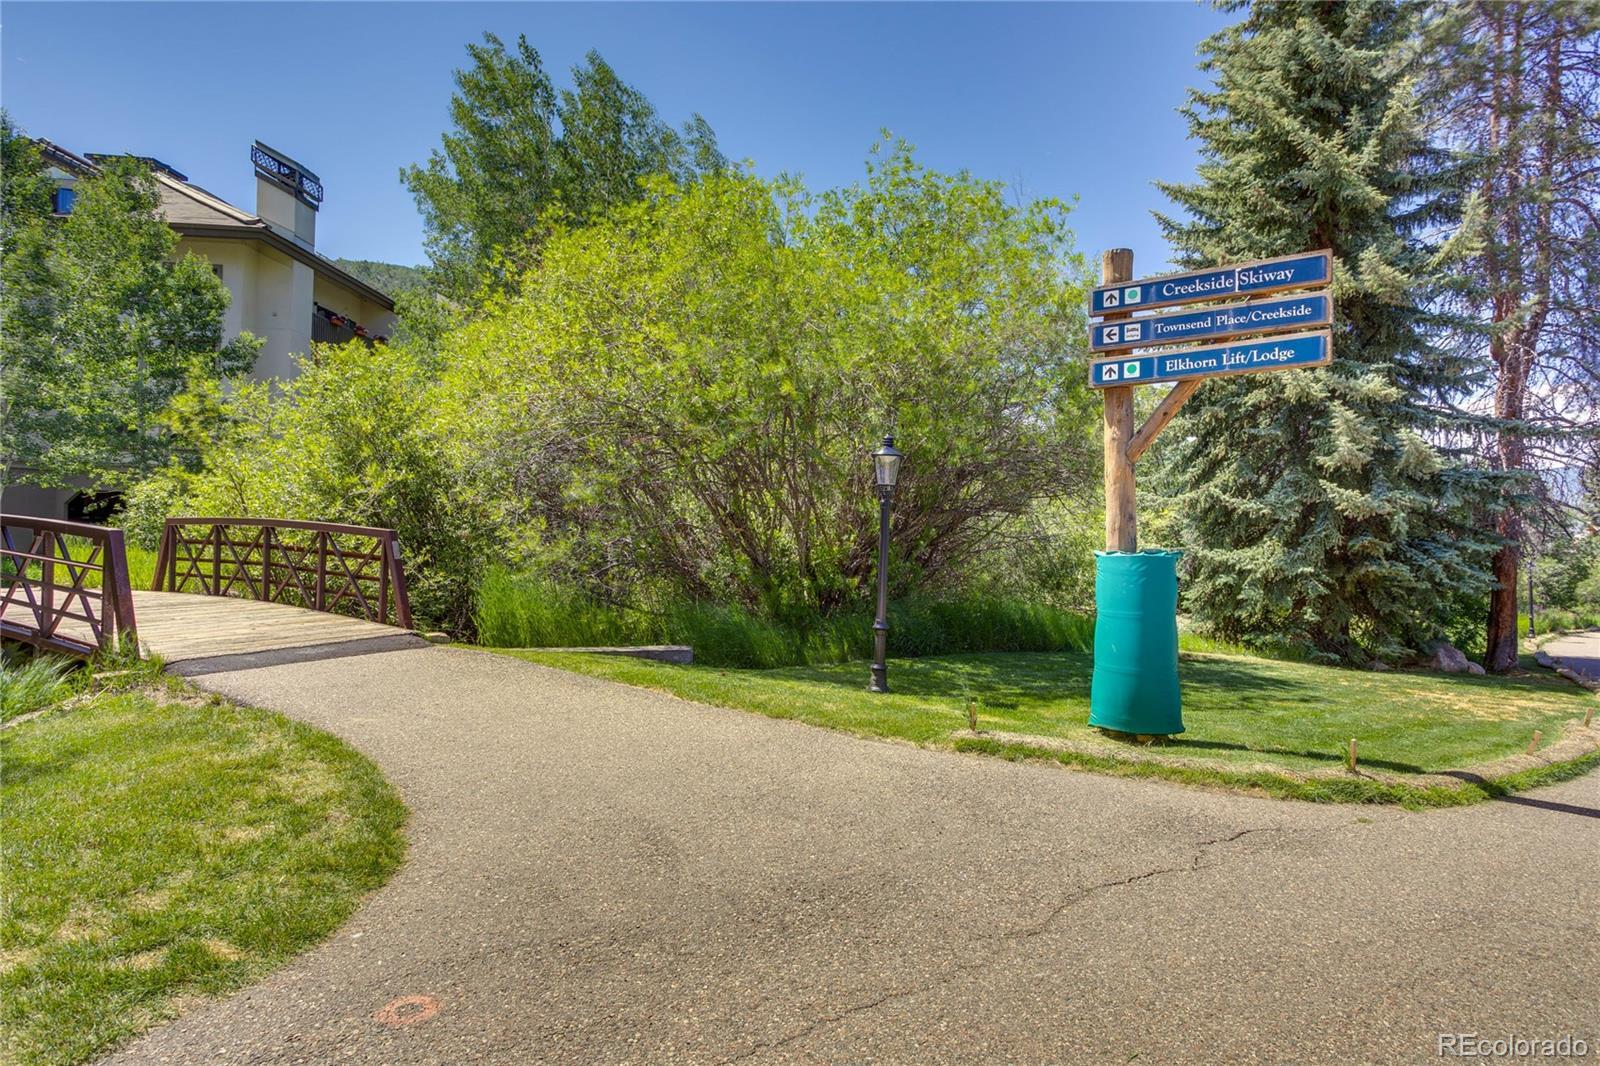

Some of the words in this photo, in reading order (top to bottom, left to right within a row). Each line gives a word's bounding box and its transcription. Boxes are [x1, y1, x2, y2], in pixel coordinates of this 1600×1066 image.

[1163, 275, 1233, 297] Creekside
[1239, 268, 1295, 287] Skiway
[1155, 317, 1212, 334] Townsend
[1216, 304, 1312, 326] Place/Creekside
[1165, 357, 1217, 372] Elkhorn
[1222, 347, 1295, 367] Lift/Lodge
